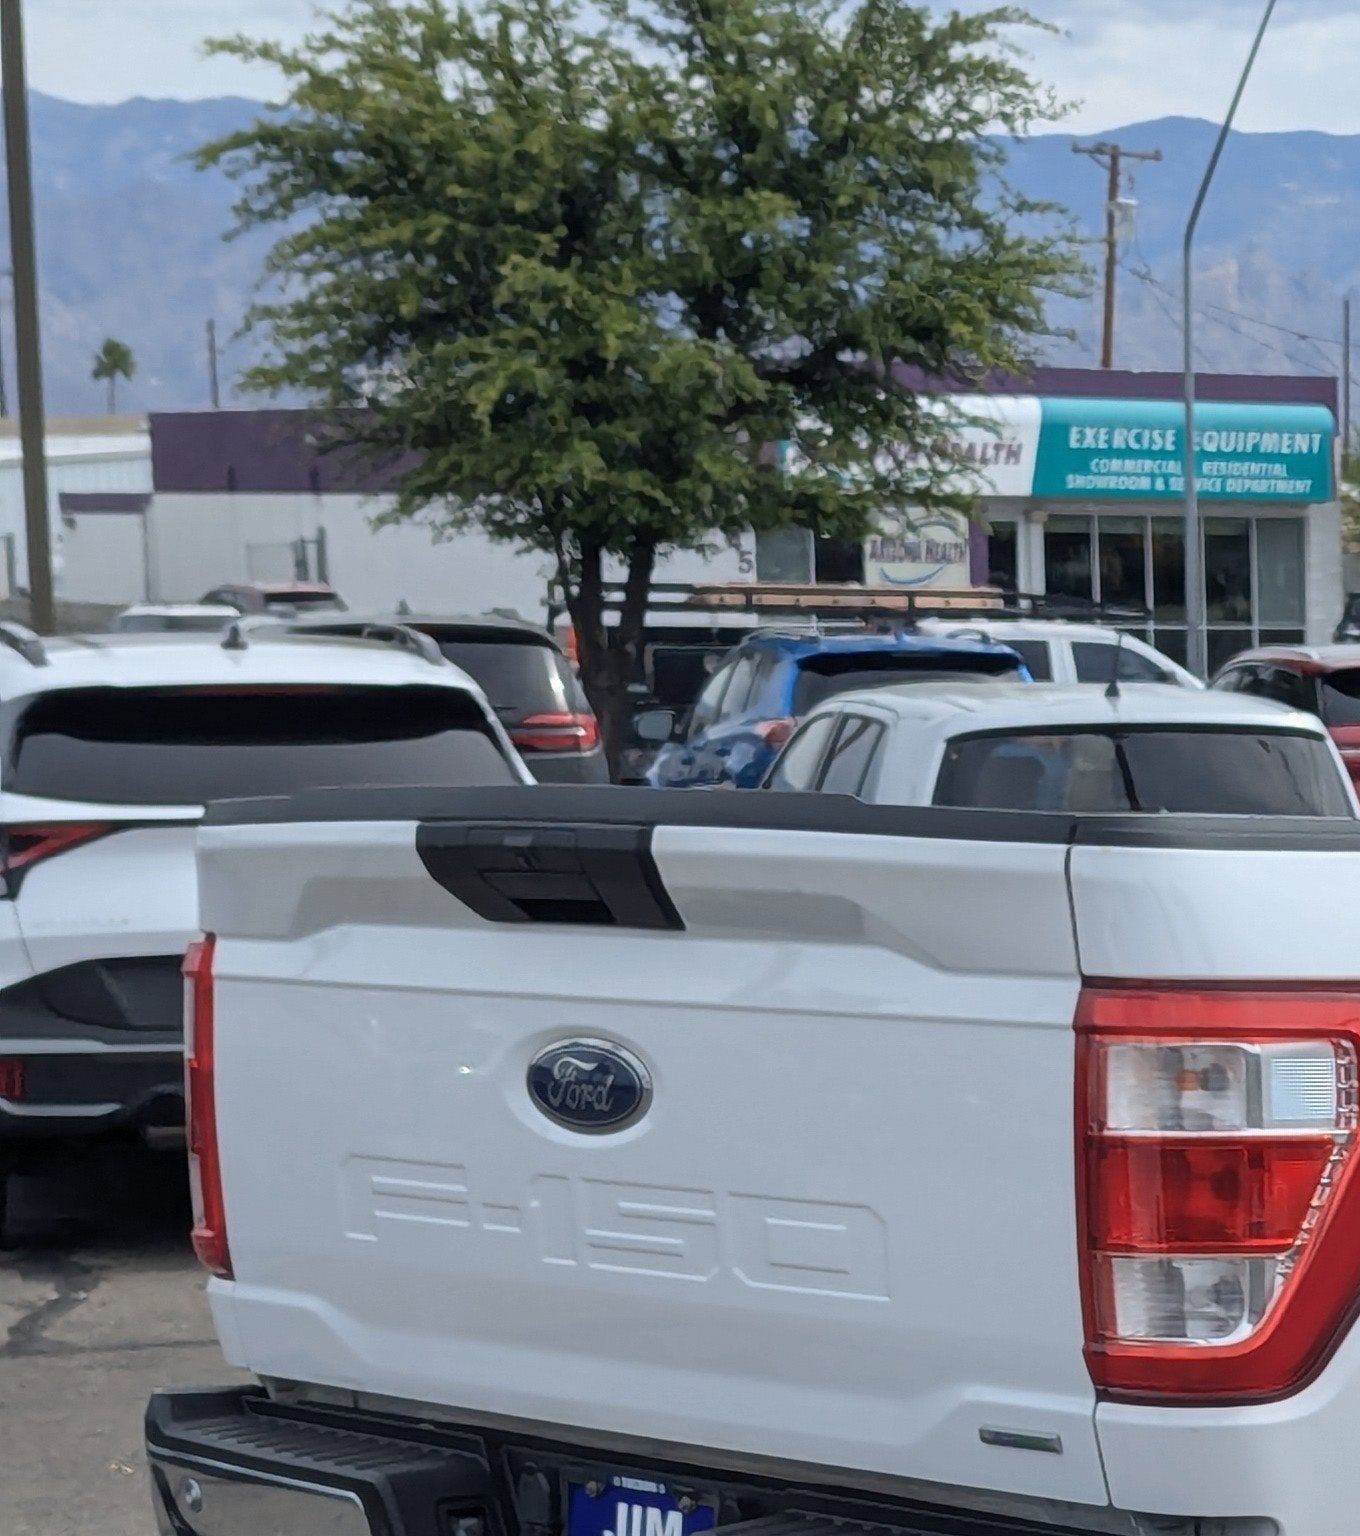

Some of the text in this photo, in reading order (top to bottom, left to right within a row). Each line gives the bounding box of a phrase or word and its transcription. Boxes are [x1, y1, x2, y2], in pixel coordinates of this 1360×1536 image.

[1069, 427, 1176, 450] EXERCISE
[1090, 459, 1288, 477] COMMERCIAL RESIDENTIAL
[1065, 475, 1151, 491] SHOWROOM
[1225, 478, 1313, 494] DEPARTMENT
[548, 1056, 614, 1112] Ford
[339, 1153, 891, 1302] F-150
